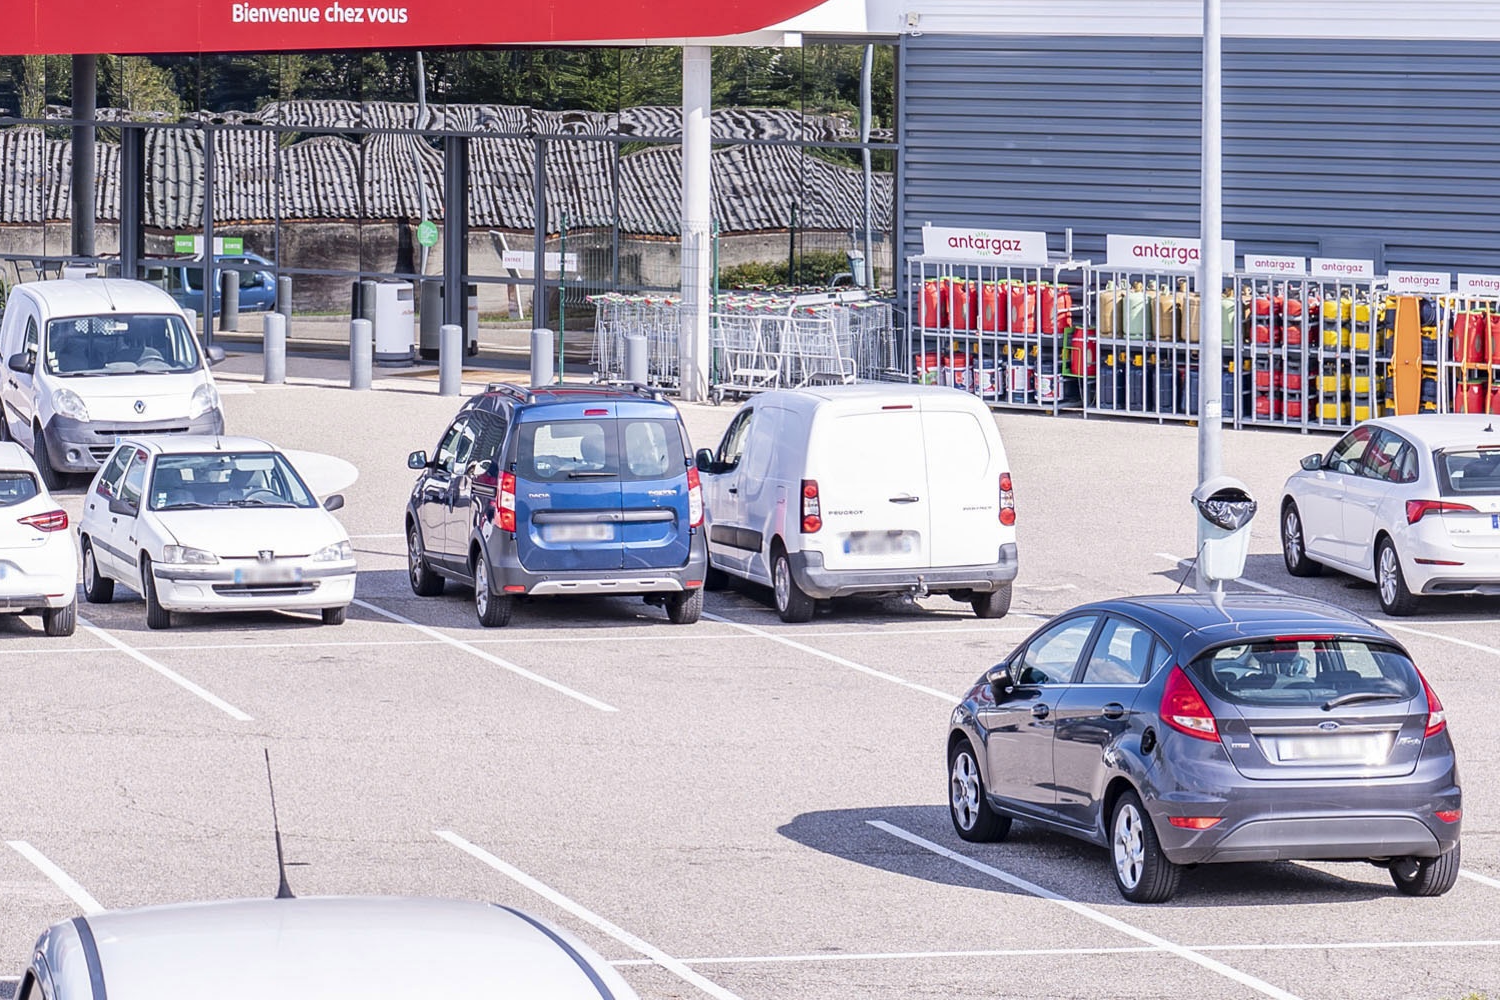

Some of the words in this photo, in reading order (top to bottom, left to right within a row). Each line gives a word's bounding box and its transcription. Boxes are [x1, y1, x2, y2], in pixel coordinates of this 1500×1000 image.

[232, 2, 320, 23] Bienvenue
[324, 2, 364, 23] chez
[367, 7, 408, 24] vous
[948, 235, 1022, 255] antargaz
[1132, 243, 1200, 265] antarga
[1254, 259, 1296, 271] antargaz
[1321, 262, 1363, 274] antargaz
[1398, 275, 1440, 287] antargaz
